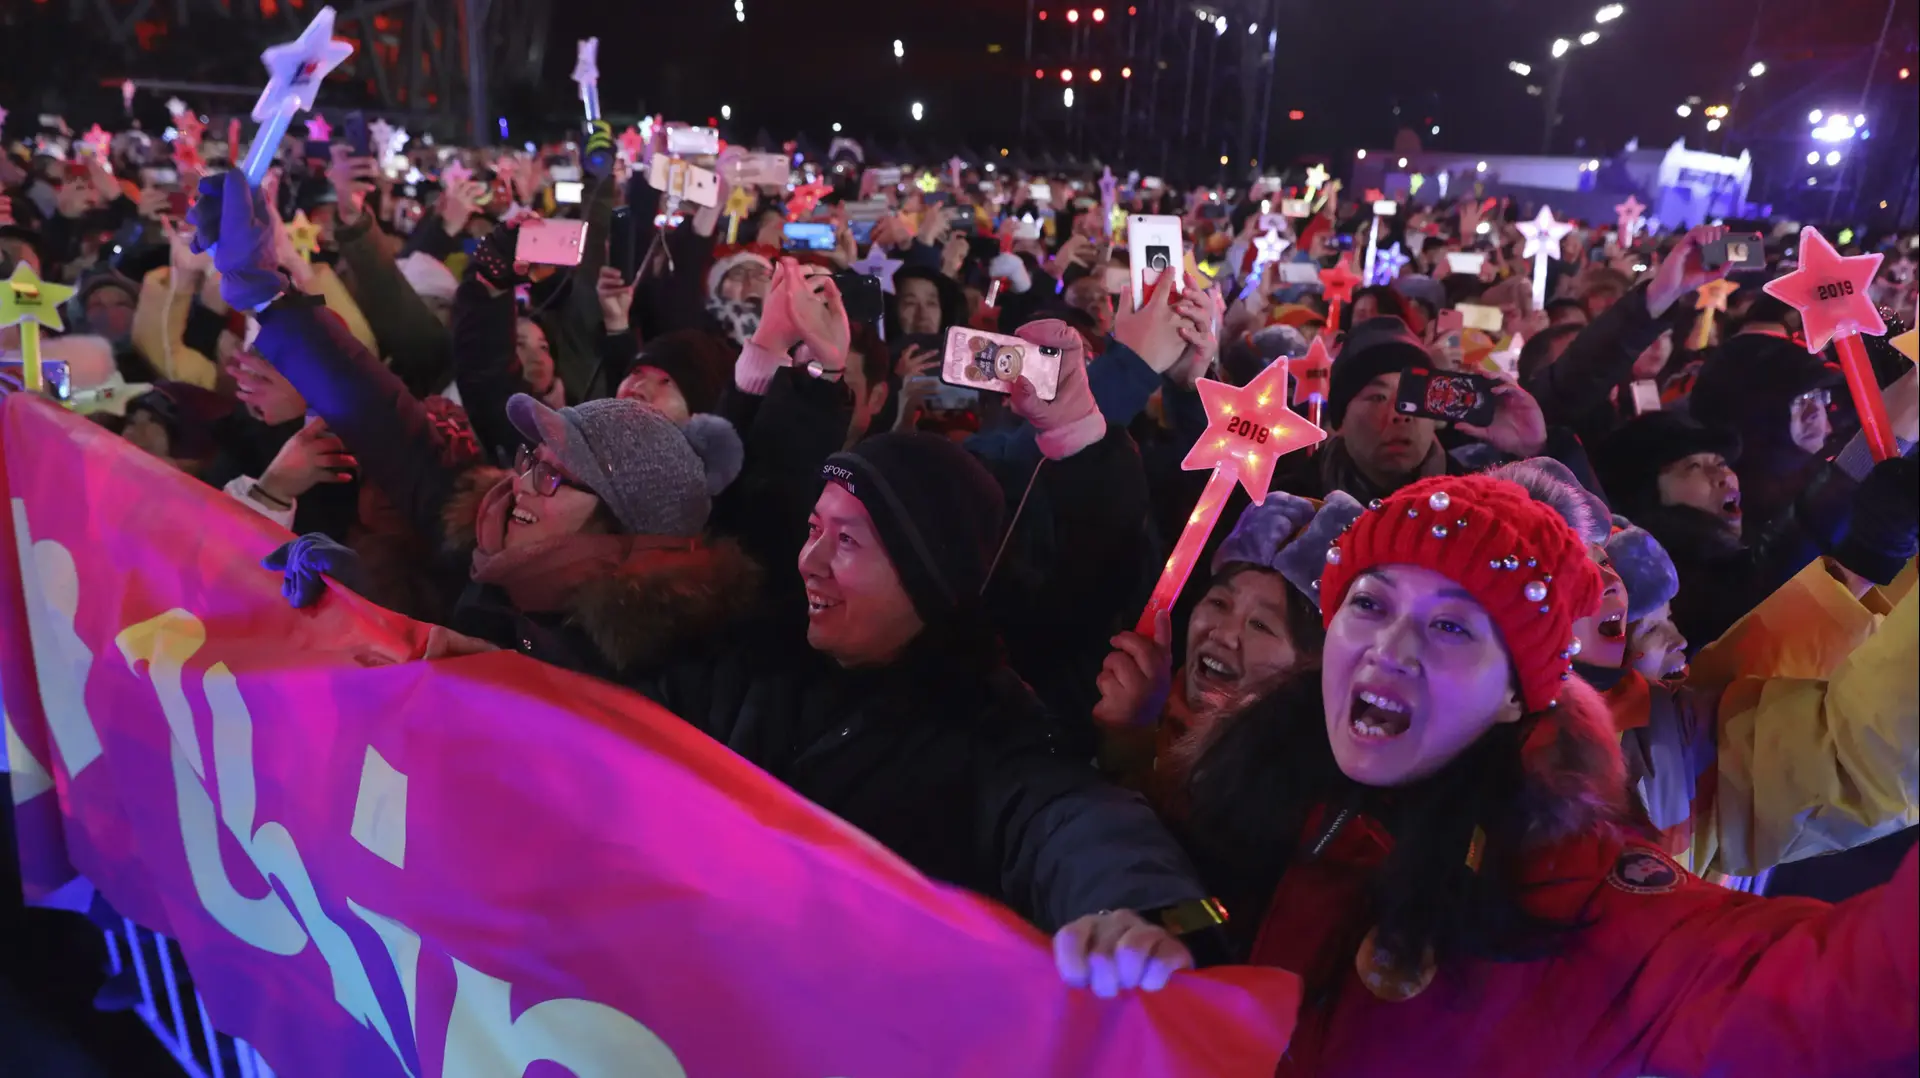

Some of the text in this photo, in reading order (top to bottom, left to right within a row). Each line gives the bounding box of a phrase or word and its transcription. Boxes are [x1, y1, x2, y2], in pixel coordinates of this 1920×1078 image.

[1817, 280, 1854, 301] 2019
[1226, 415, 1270, 445] 2019
[822, 464, 854, 480] SPORT
